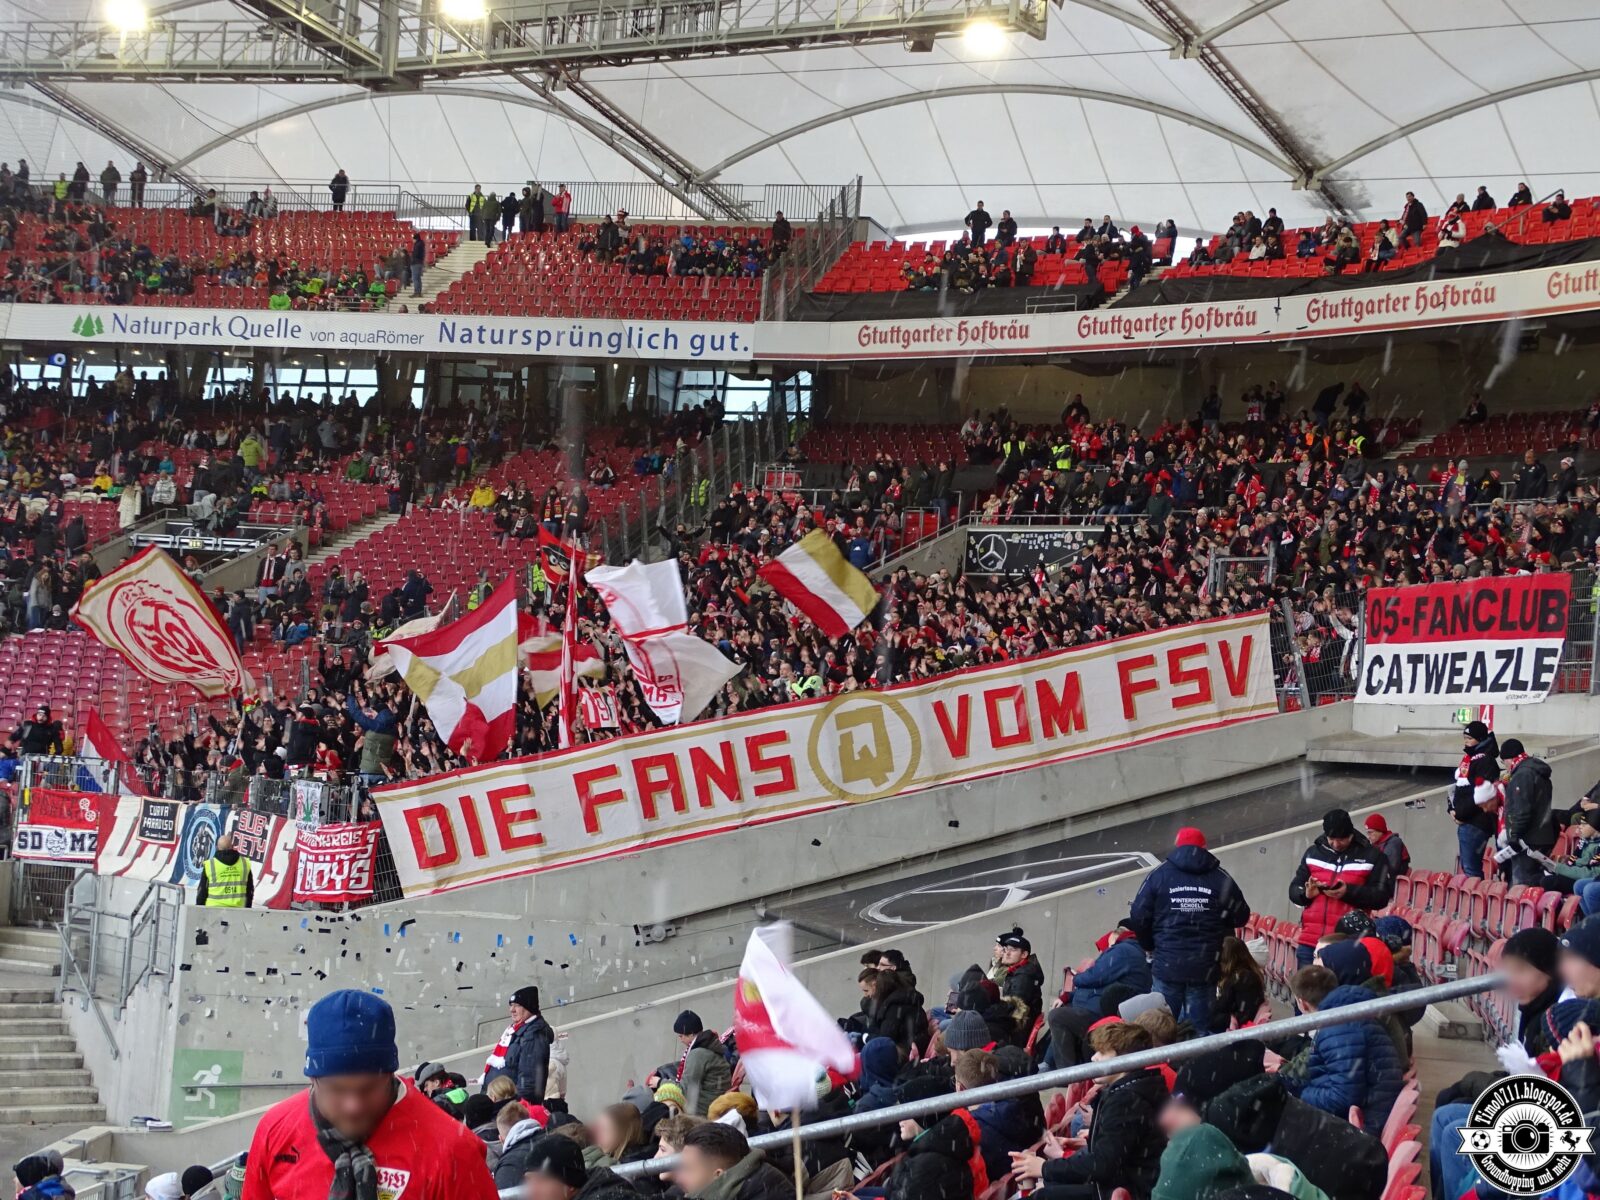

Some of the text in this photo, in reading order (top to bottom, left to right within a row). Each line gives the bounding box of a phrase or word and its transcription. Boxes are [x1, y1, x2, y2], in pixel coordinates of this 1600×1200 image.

[1547, 268, 1600, 299] Stutt
[1306, 281, 1496, 324] Stuttgarter Hofbräu
[310, 330, 335, 343] von
[340, 329, 425, 346] aquaRömer
[438, 321, 749, 357] Natursprünglich gut.
[857, 318, 1030, 349] Stuttgarter Hofbräu
[1077, 305, 1257, 340] Stuttgarter Hofbräu
[1369, 588, 1568, 638] 05-FANCLUB
[1365, 646, 1559, 696] CATWEAZLE
[1481, 704, 1491, 728] 4
[402, 783, 545, 871] DIE
[572, 729, 799, 834] FANS
[933, 671, 1088, 759] VOM
[1117, 634, 1255, 721] FSV
[238, 811, 268, 836] SUB
[18, 831, 98, 852] SD MZ
